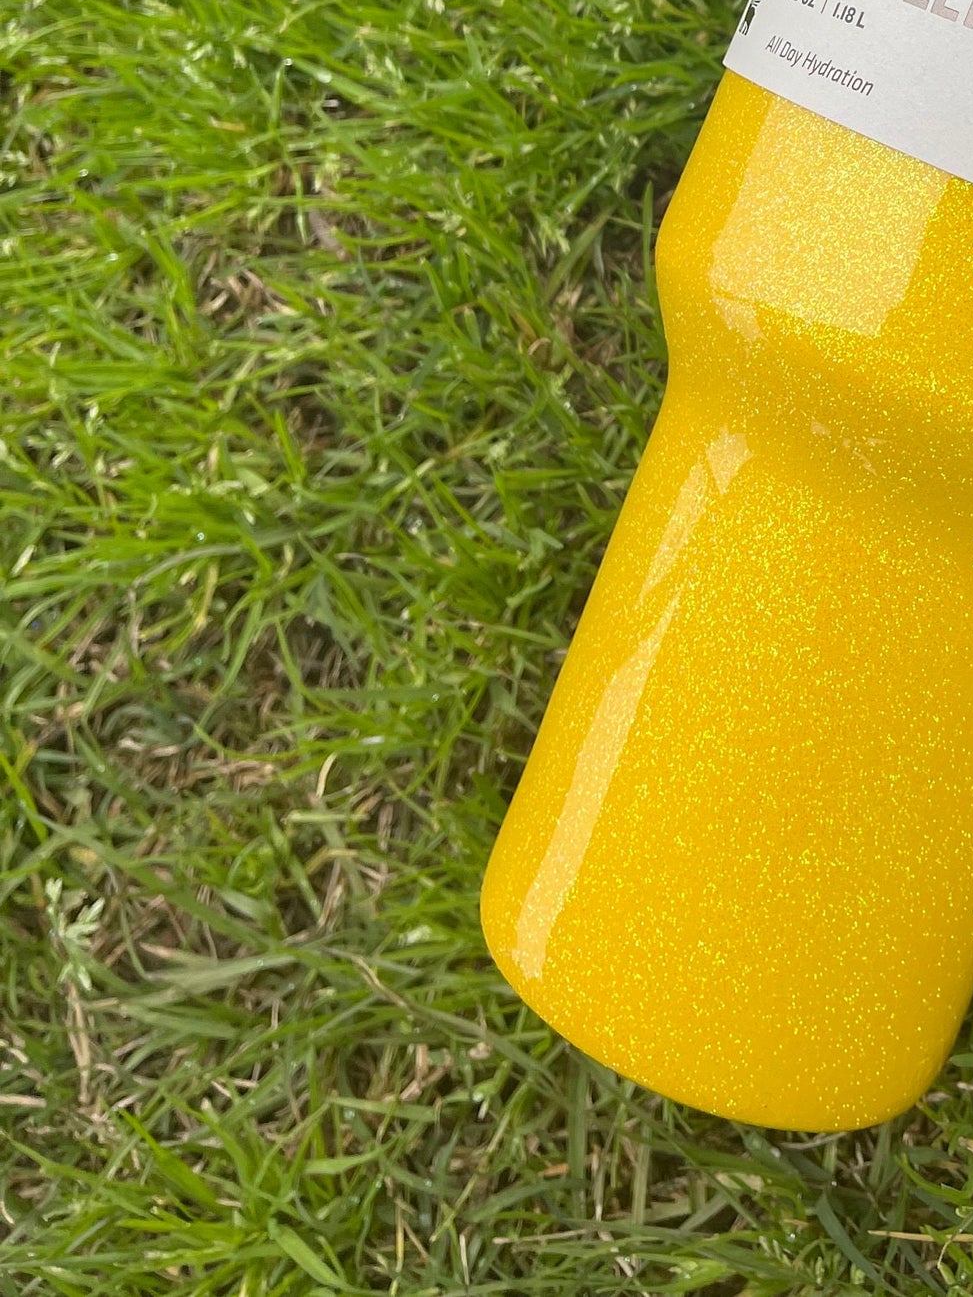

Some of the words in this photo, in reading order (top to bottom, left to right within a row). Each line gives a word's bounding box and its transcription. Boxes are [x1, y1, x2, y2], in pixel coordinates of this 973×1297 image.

[832, 2, 857, 23] 1.18
[856, 11, 865, 29] L
[765, 35, 784, 54] All
[780, 41, 803, 68] Day
[802, 51, 875, 96] Hydration
